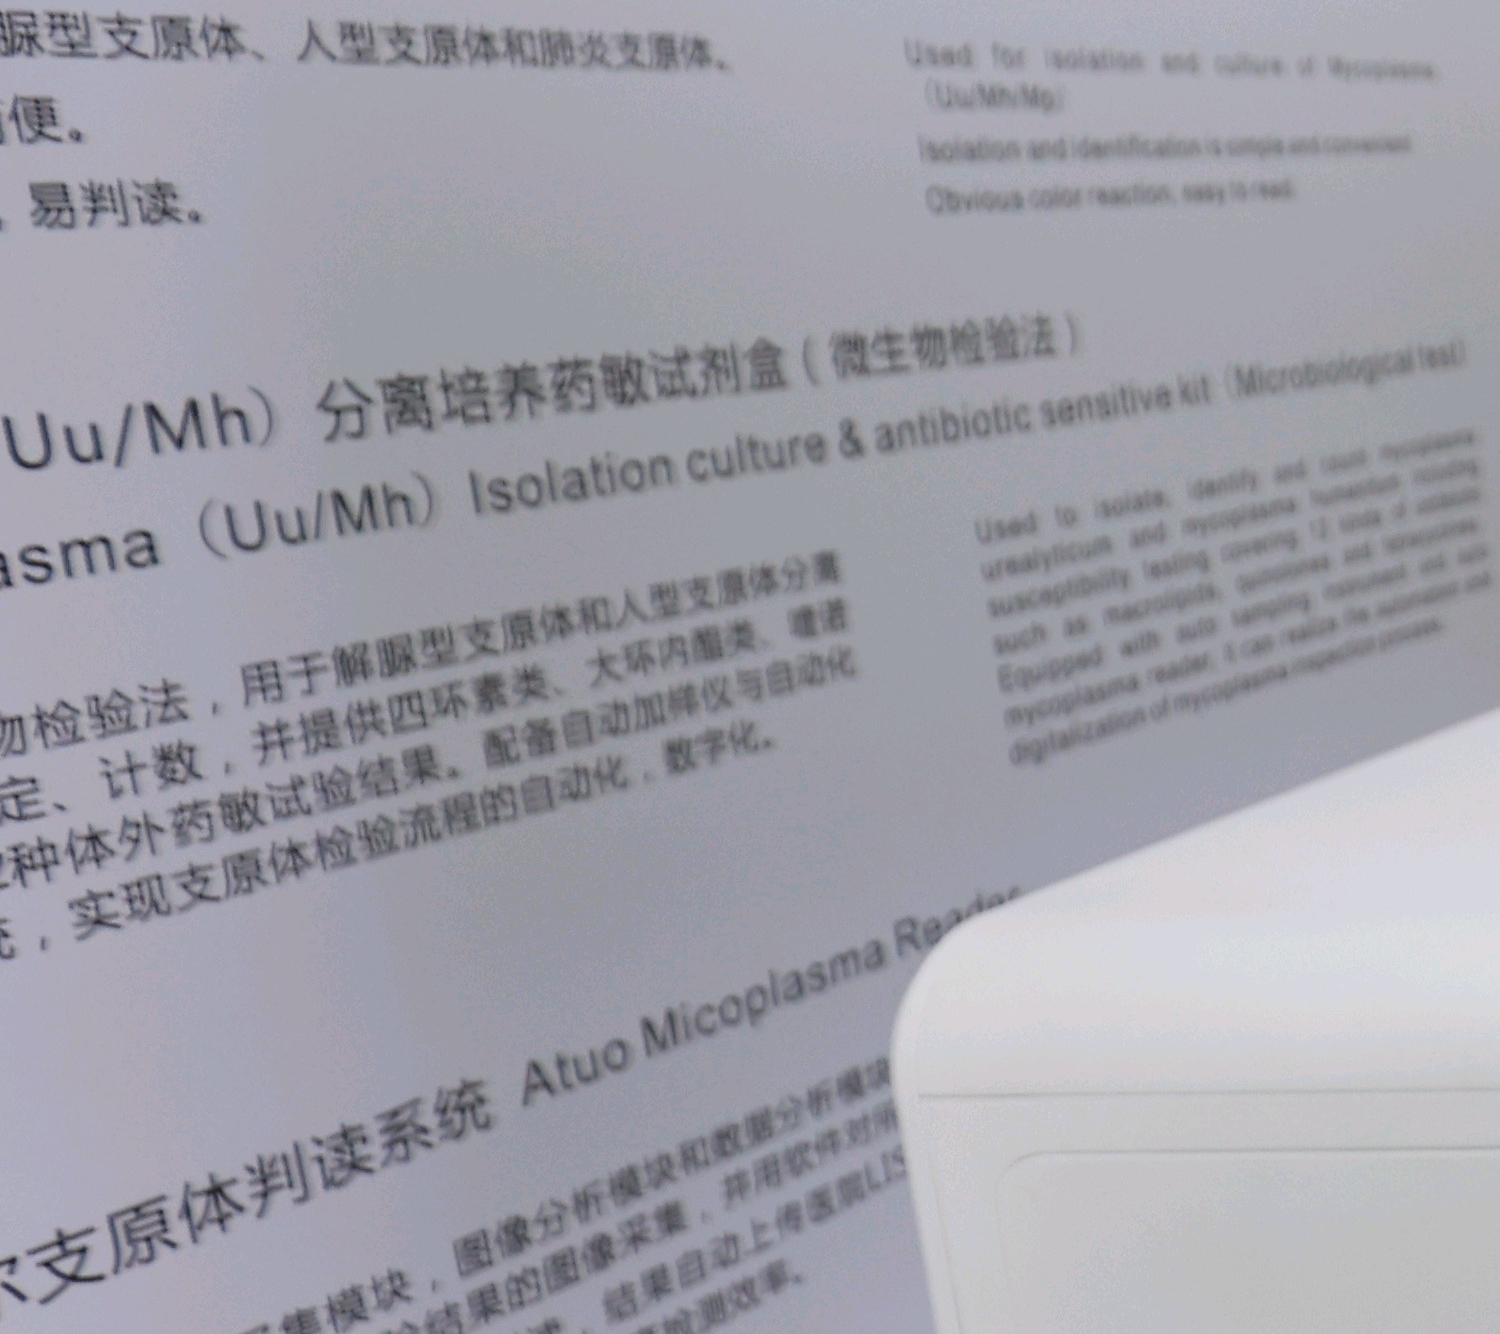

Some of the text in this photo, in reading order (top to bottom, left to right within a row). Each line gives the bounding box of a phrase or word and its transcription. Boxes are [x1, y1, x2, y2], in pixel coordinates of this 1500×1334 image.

[0, 94, 82, 144] 便。
[468, 453, 676, 518] Isolation
[685, 429, 827, 484] culture
[838, 417, 866, 460] &
[873, 398, 1032, 456] antibiotic
[1038, 383, 1170, 430] sensitive
[1178, 371, 1210, 407] kit
[519, 1034, 632, 1111] Atuo
[638, 939, 886, 1058] Micoplasma
